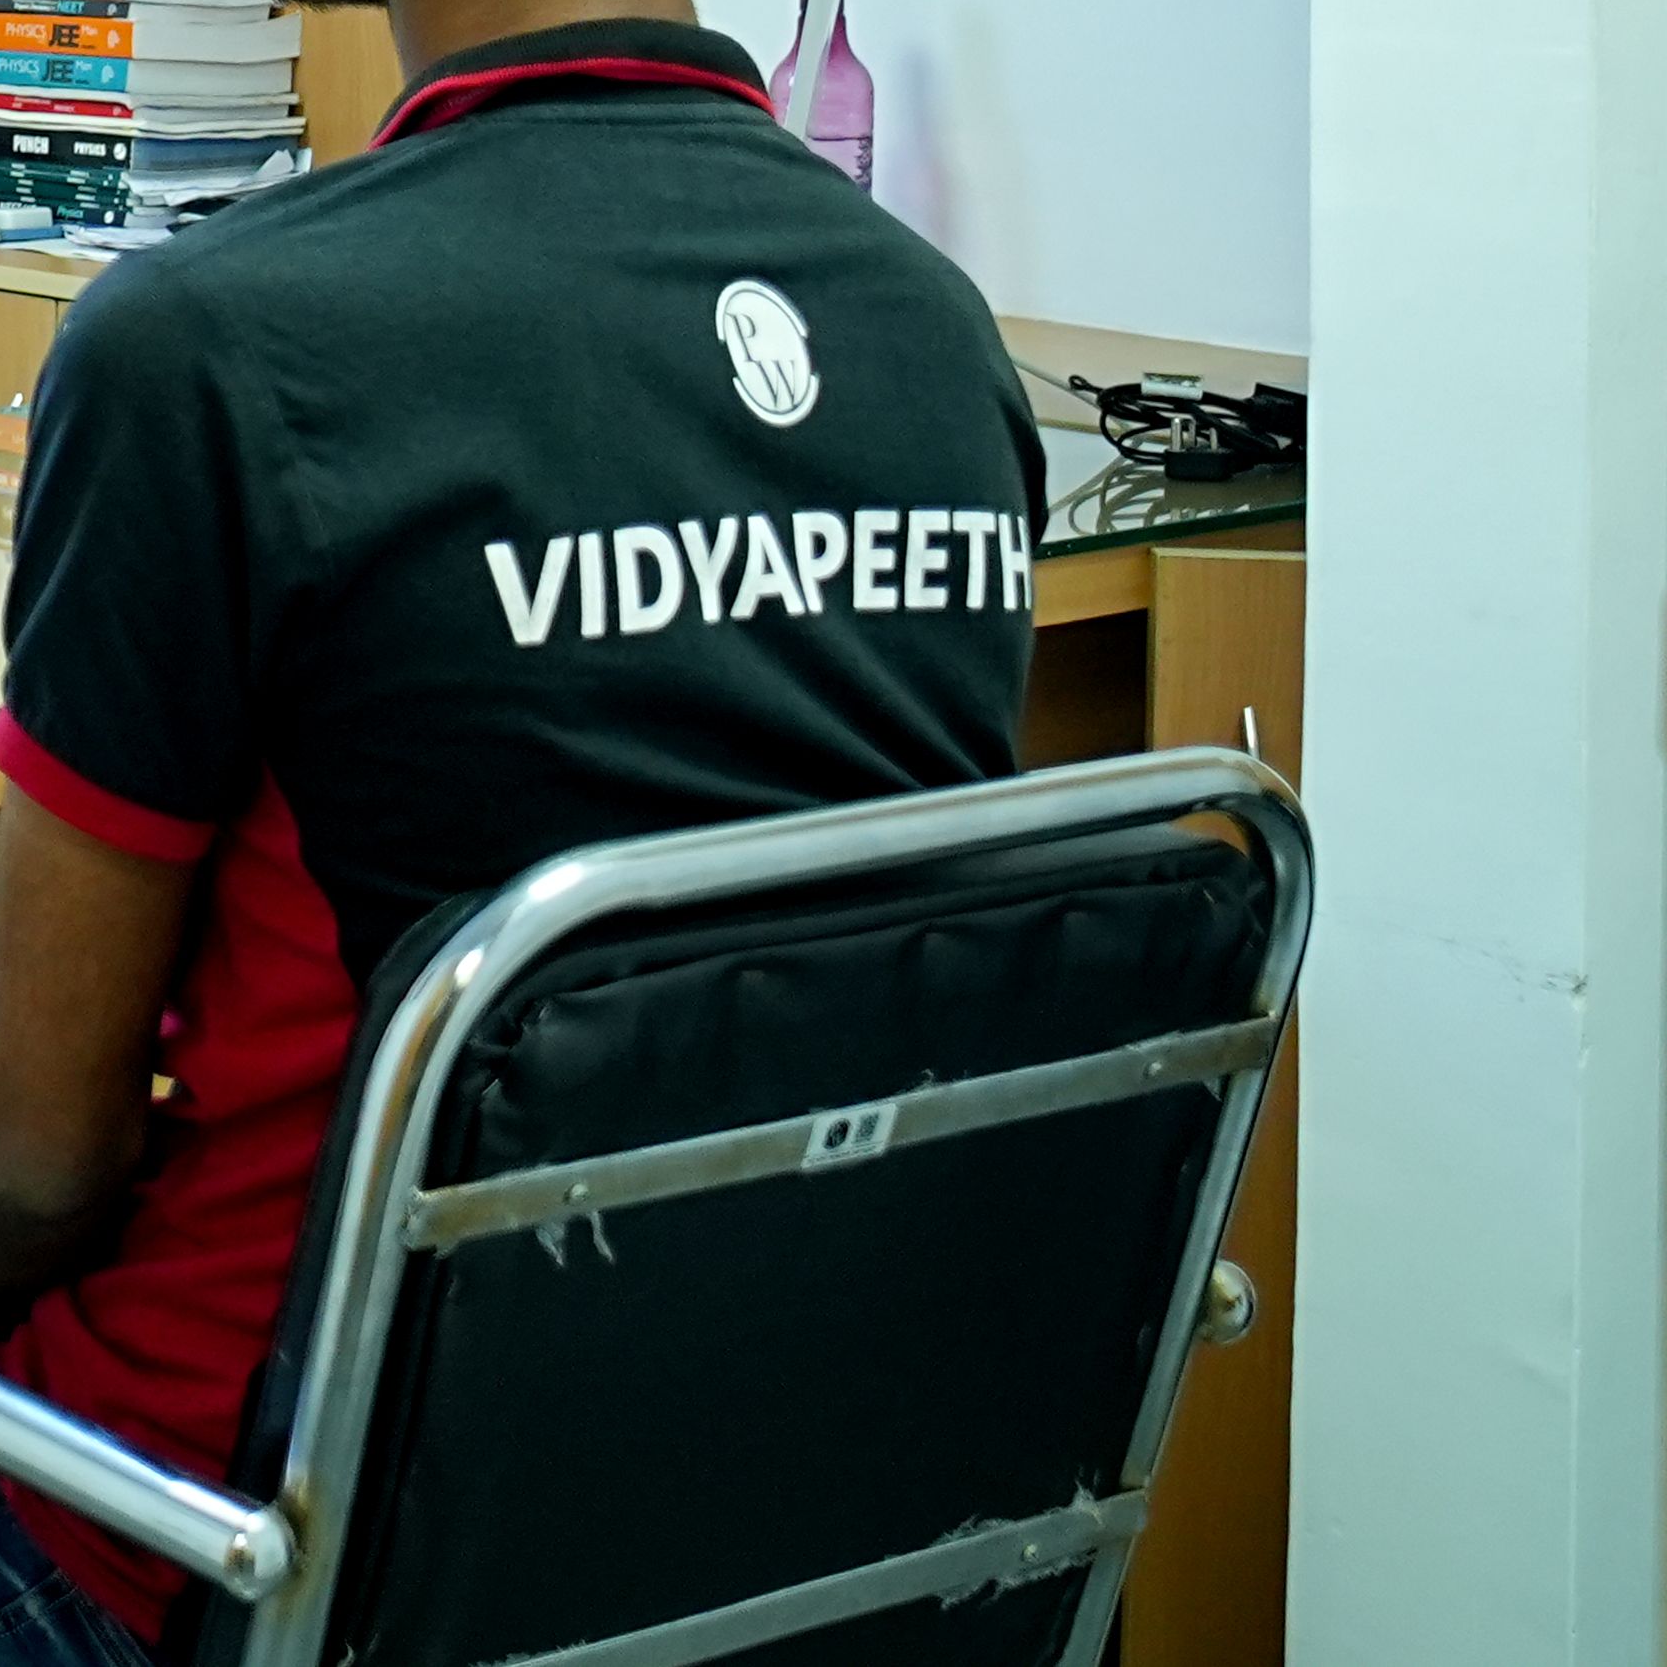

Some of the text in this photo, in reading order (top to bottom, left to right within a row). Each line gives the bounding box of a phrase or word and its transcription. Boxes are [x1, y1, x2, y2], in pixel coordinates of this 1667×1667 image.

[5, 22, 80, 48] PHYSICS JEE
[42, 59, 74, 83] JEE
[12, 134, 50, 155] PUNCH
[483, 509, 1034, 648] VIDYAPEETH
